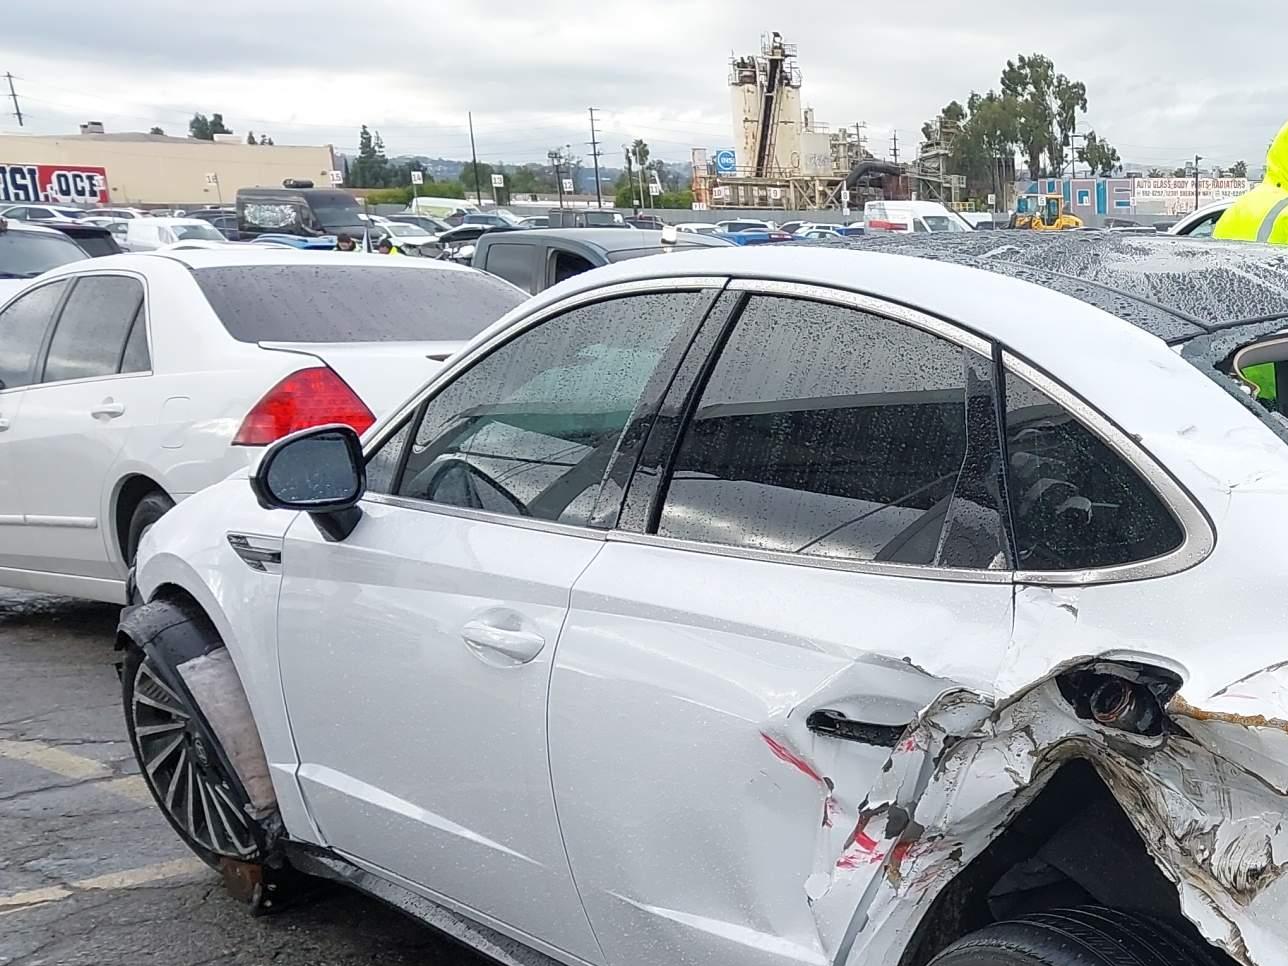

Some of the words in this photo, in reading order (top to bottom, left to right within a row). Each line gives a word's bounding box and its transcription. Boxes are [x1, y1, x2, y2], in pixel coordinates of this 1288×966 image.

[331, 172, 341, 182] 15
[413, 173, 422, 183] 14
[563, 182, 573, 191] 12
[1136, 181, 1151, 189] AUTO
[1191, 181, 1246, 189] PRTS-RADIATORS
[714, 188, 722, 197] 10
